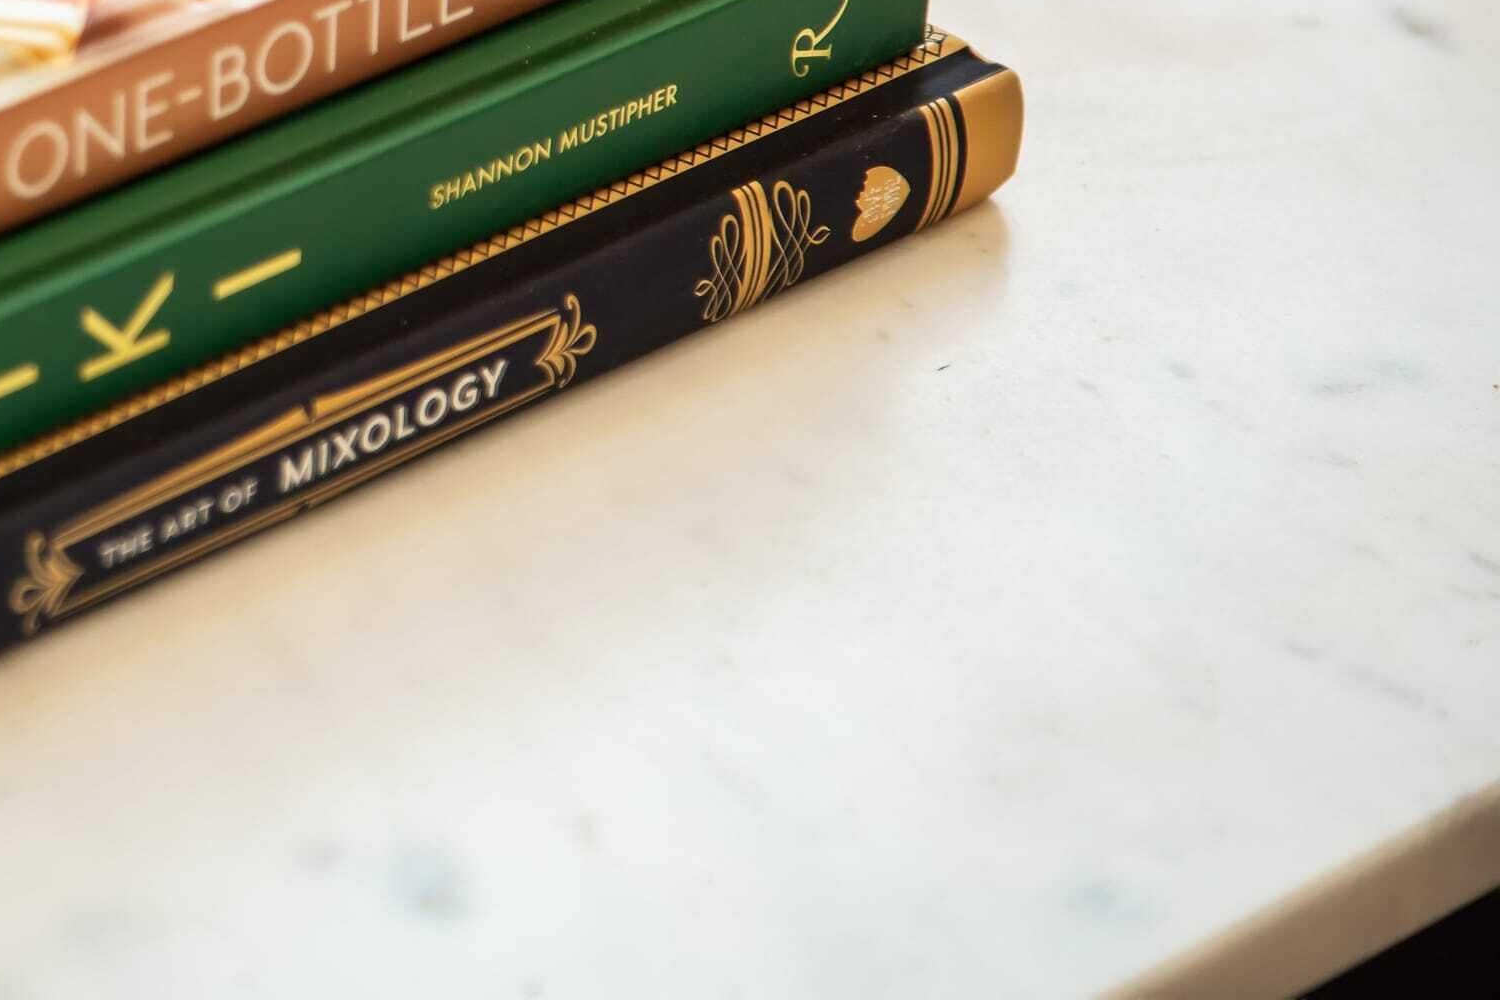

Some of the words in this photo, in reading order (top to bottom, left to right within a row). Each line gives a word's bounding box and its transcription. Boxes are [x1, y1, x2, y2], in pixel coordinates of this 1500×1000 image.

[430, 137, 552, 210] SHANNON
[558, 83, 678, 154] MUSTIPHER
[100, 526, 155, 569] THE
[159, 500, 213, 543] ART
[220, 477, 260, 516] OF
[278, 358, 508, 493] MIXOLOGY
